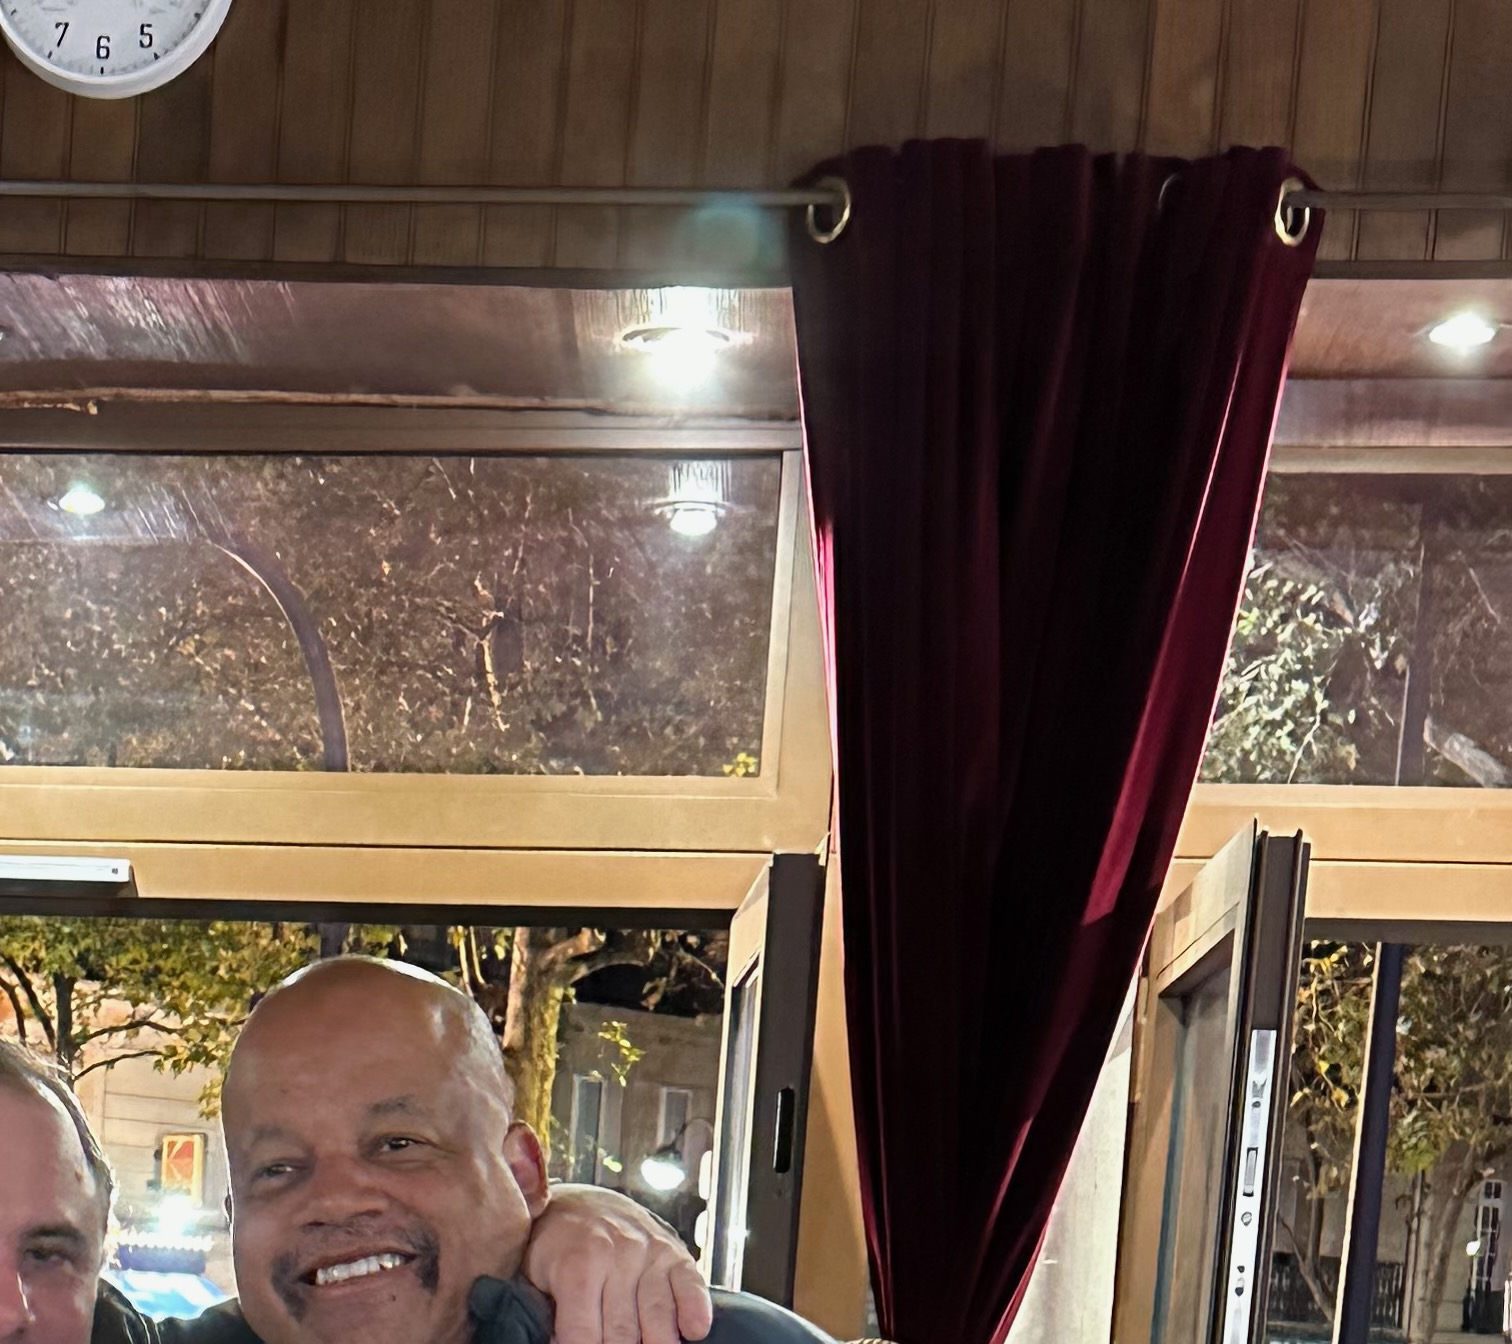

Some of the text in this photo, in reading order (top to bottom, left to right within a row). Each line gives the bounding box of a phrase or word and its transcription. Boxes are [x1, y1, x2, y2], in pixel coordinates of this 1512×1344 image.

[55, 22, 69, 48] 7
[96, 35, 110, 60] 6
[139, 23, 153, 48] 5
